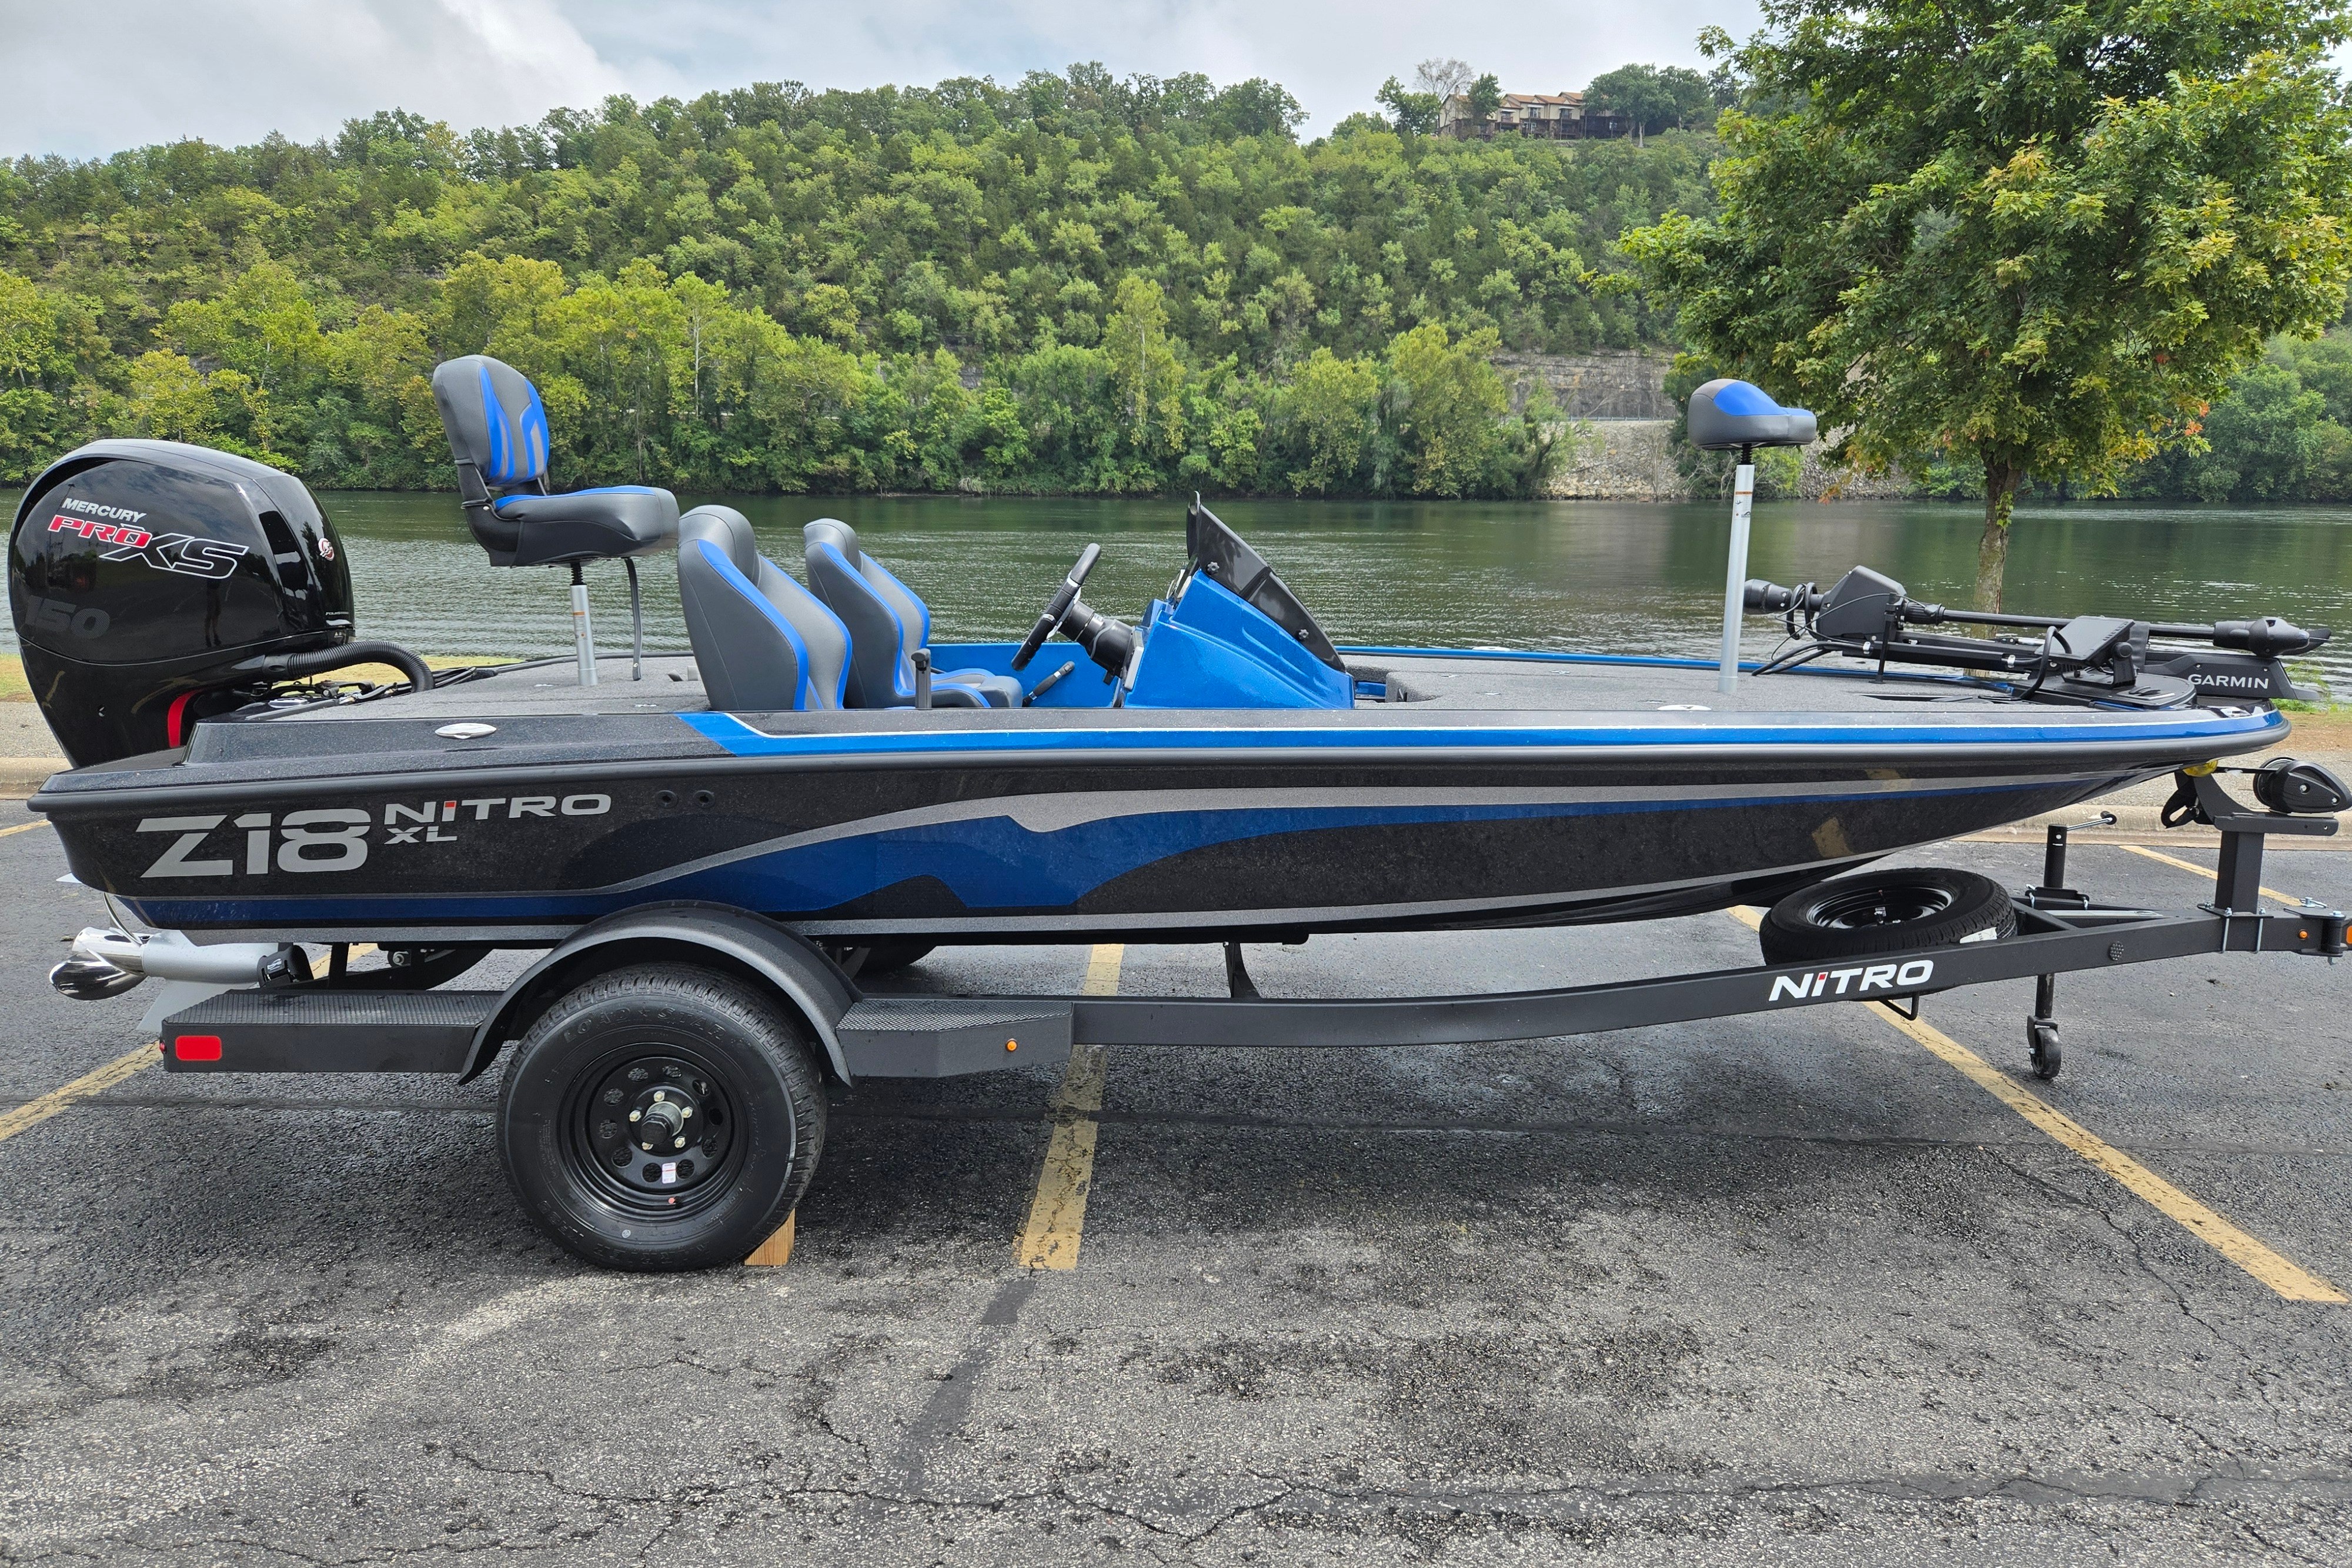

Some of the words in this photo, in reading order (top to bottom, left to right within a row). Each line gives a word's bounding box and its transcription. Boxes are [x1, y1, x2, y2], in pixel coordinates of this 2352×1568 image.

[62, 498, 146, 522] MERCURY
[48, 514, 152, 549] PRO
[99, 523, 249, 579] XS
[24, 594, 111, 640] 150
[2188, 674, 2269, 689] GARMIN
[135, 808, 372, 878] Z18
[384, 826, 458, 844] XL
